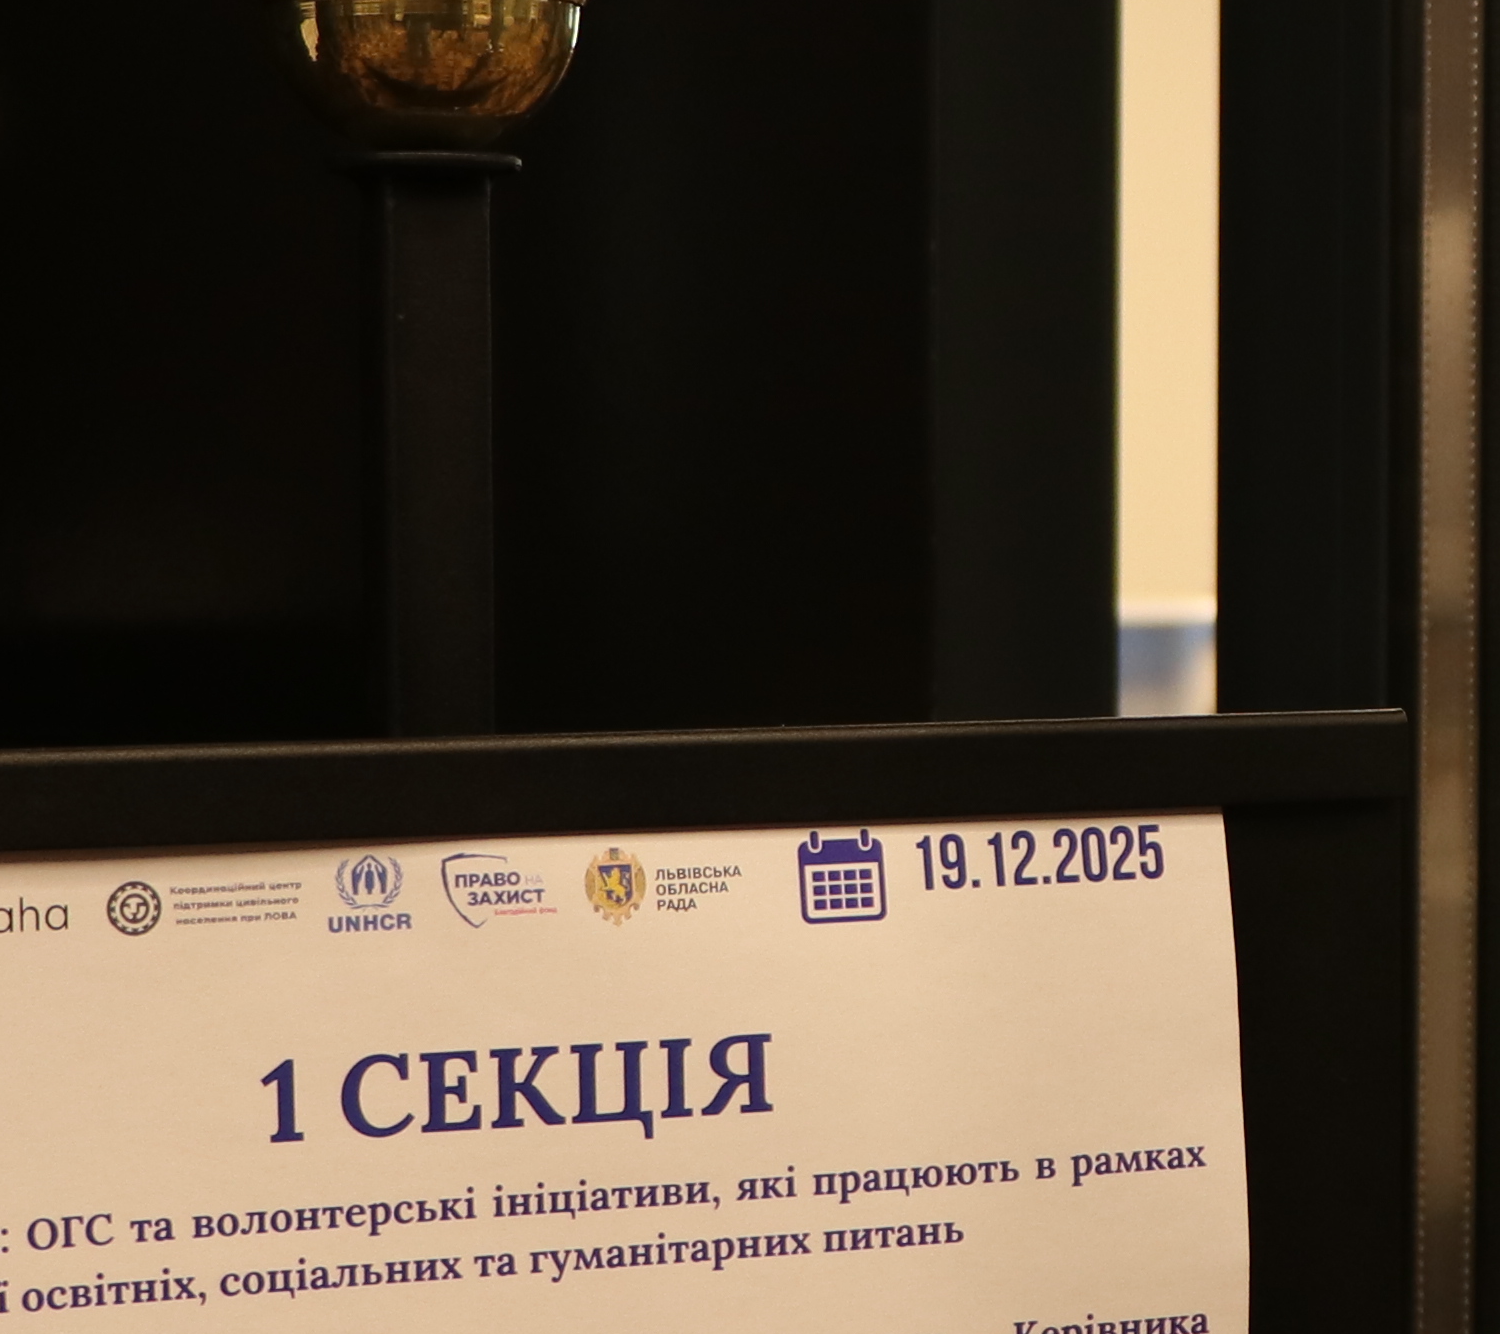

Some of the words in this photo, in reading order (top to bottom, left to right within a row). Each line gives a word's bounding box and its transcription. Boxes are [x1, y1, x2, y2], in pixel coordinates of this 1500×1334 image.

[914, 823, 1166, 892] 19.12.2025
[455, 871, 521, 888] ПРАВО
[655, 865, 742, 881] ЛЬВІВСЬКА
[467, 888, 546, 906] ЗАХИСТ
[656, 881, 729, 896] ОБЛАСНА
[657, 898, 697, 912] РАДА
[264, 911, 297, 921] ЛОВА
[327, 912, 413, 935] UNHCR
[258, 1057, 306, 1145] 1
[338, 1031, 776, 1142] СЕКЦІЯ
[25, 1211, 116, 1252] ОГС
[128, 1216, 178, 1245] та
[190, 1184, 479, 1241] волонтерські
[490, 1177, 722, 1222] ініціативи,
[734, 1163, 799, 1203] які
[810, 1159, 1022, 1206] працюють
[1033, 1156, 1058, 1181] в
[1068, 1144, 1209, 1189] рамках
[19, 1266, 208, 1314] освітніх,
[217, 1255, 465, 1301] соціальних
[471, 1251, 520, 1279] та
[527, 1230, 814, 1285] гуманітарних
[821, 1220, 966, 1255] питань
